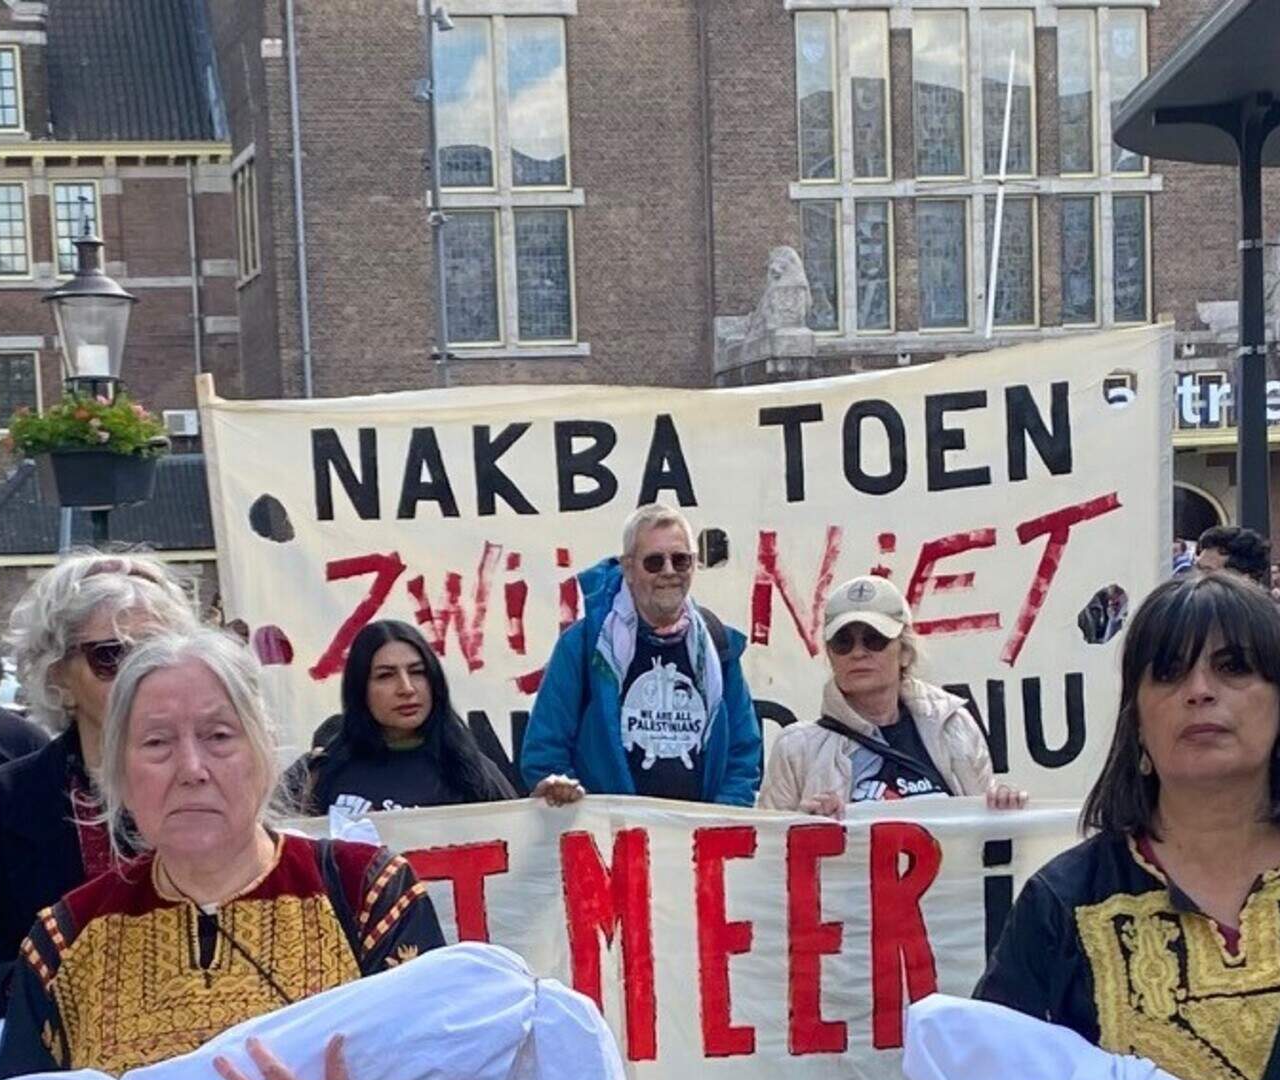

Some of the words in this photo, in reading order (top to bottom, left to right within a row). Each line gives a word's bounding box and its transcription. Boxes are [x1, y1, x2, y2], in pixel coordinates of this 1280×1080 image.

[312, 413, 698, 521] NAKBA
[759, 381, 1074, 502] TOEN
[656, 710, 672, 721] ARE
[676, 710, 691, 721] ALL
[560, 820, 943, 1061] MEER
